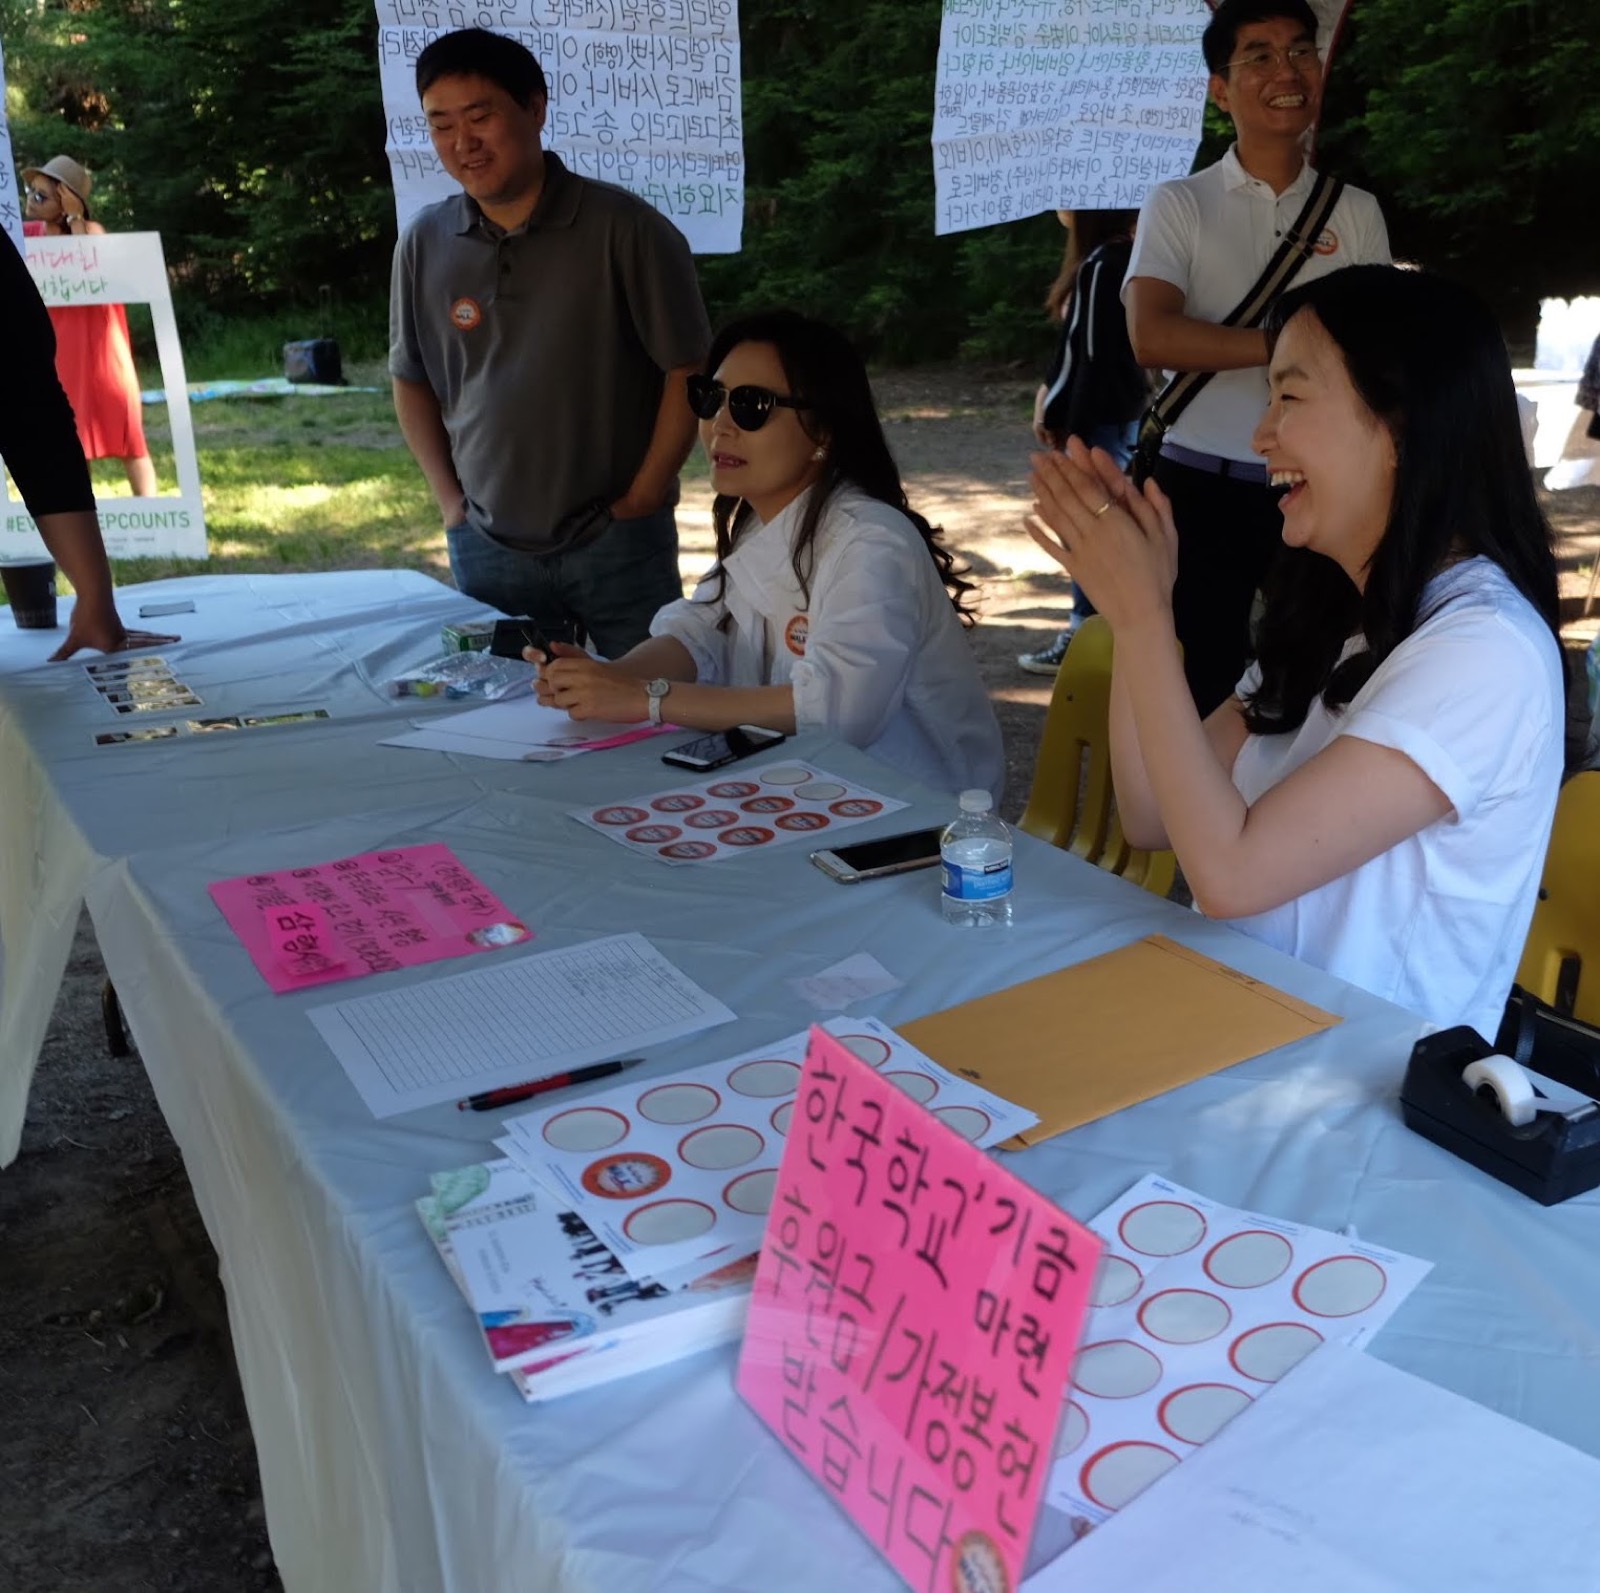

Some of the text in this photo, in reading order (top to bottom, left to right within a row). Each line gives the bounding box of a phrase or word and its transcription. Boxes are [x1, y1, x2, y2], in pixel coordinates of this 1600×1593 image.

[26, 240, 98, 271] 기대회
[6, 511, 191, 533] #EVEPCOUNTS
[974, 1288, 1052, 1399] 마련
